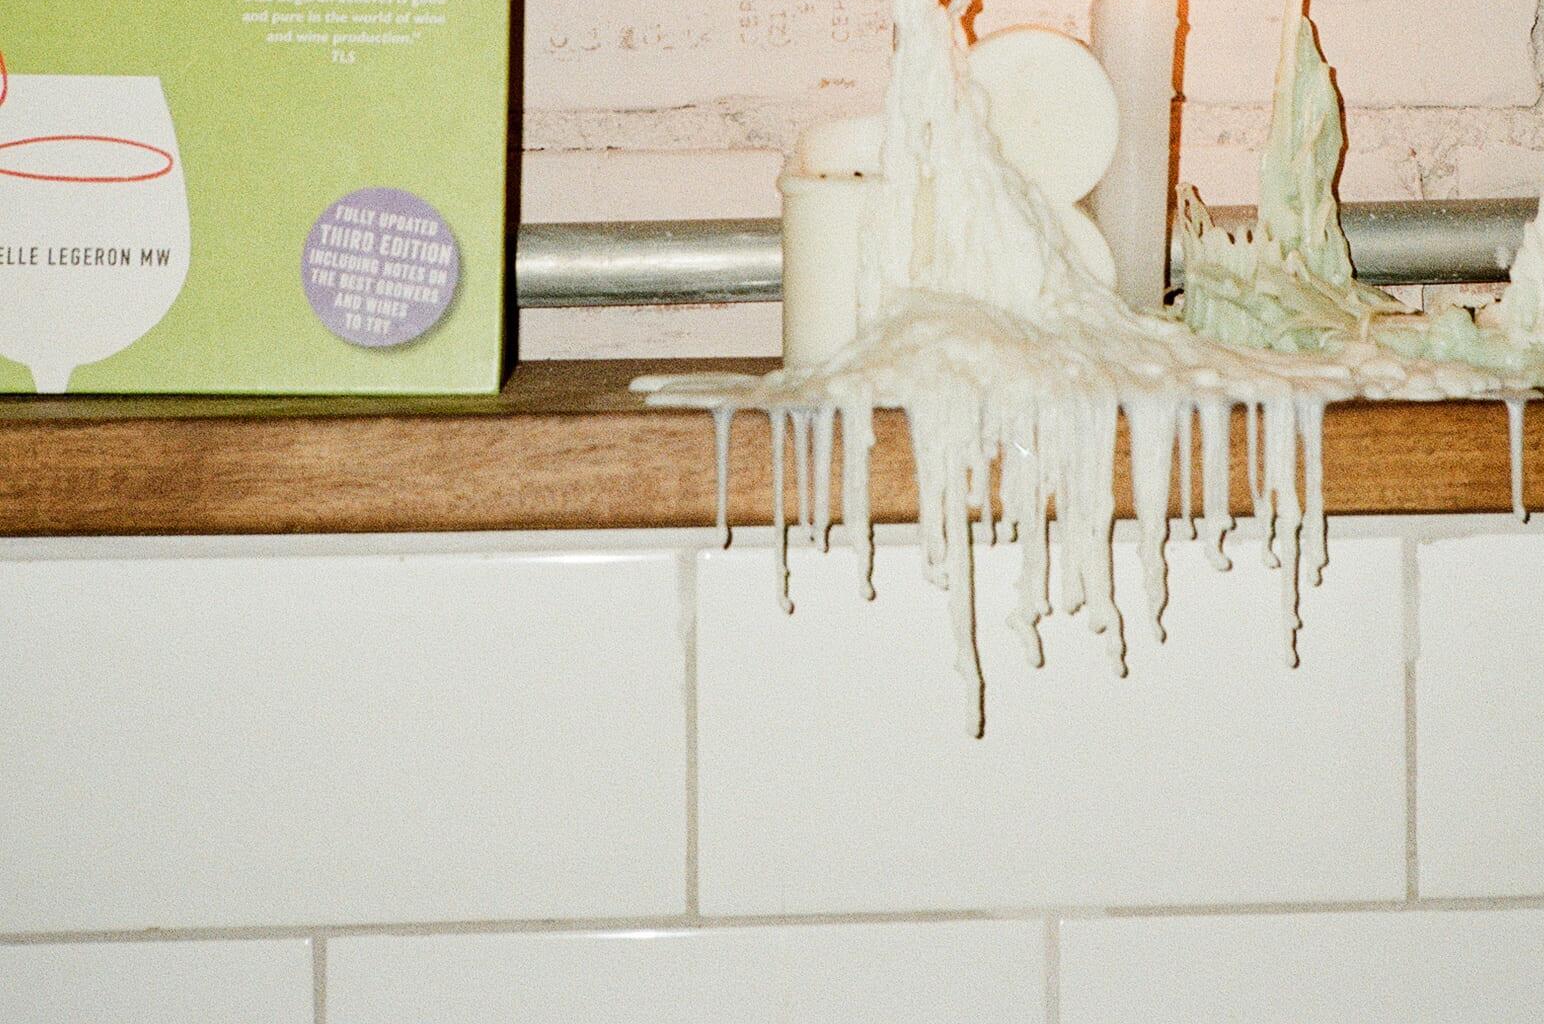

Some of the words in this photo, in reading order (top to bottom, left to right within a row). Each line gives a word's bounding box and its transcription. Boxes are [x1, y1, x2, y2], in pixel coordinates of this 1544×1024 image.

[242, 11, 268, 24] and
[271, 12, 304, 26] pure
[308, 12, 321, 23] in
[325, 11, 348, 24] the
[351, 11, 392, 24] world
[395, 12, 411, 24] of
[413, 13, 446, 25] wine
[266, 31, 293, 43] and
[296, 33, 329, 44] wine
[331, 48, 357, 64] TLS
[335, 204, 376, 226] FULLY
[379, 212, 439, 236] UPDATED
[319, 224, 375, 253] THIRD
[380, 234, 453, 264] EDITION
[48, 247, 131, 266] LEGERON
[140, 247, 171, 267] MW
[309, 248, 379, 274] INCLUDING
[383, 261, 427, 282] NOTES
[429, 268, 448, 286] ON
[311, 268, 336, 287] THE
[339, 273, 374, 292] BEST
[375, 278, 440, 304] GROWERS
[334, 292, 363, 310] AND
[365, 297, 410, 318] WINES
[345, 313, 362, 330] TO
[366, 316, 391, 335] TRY
